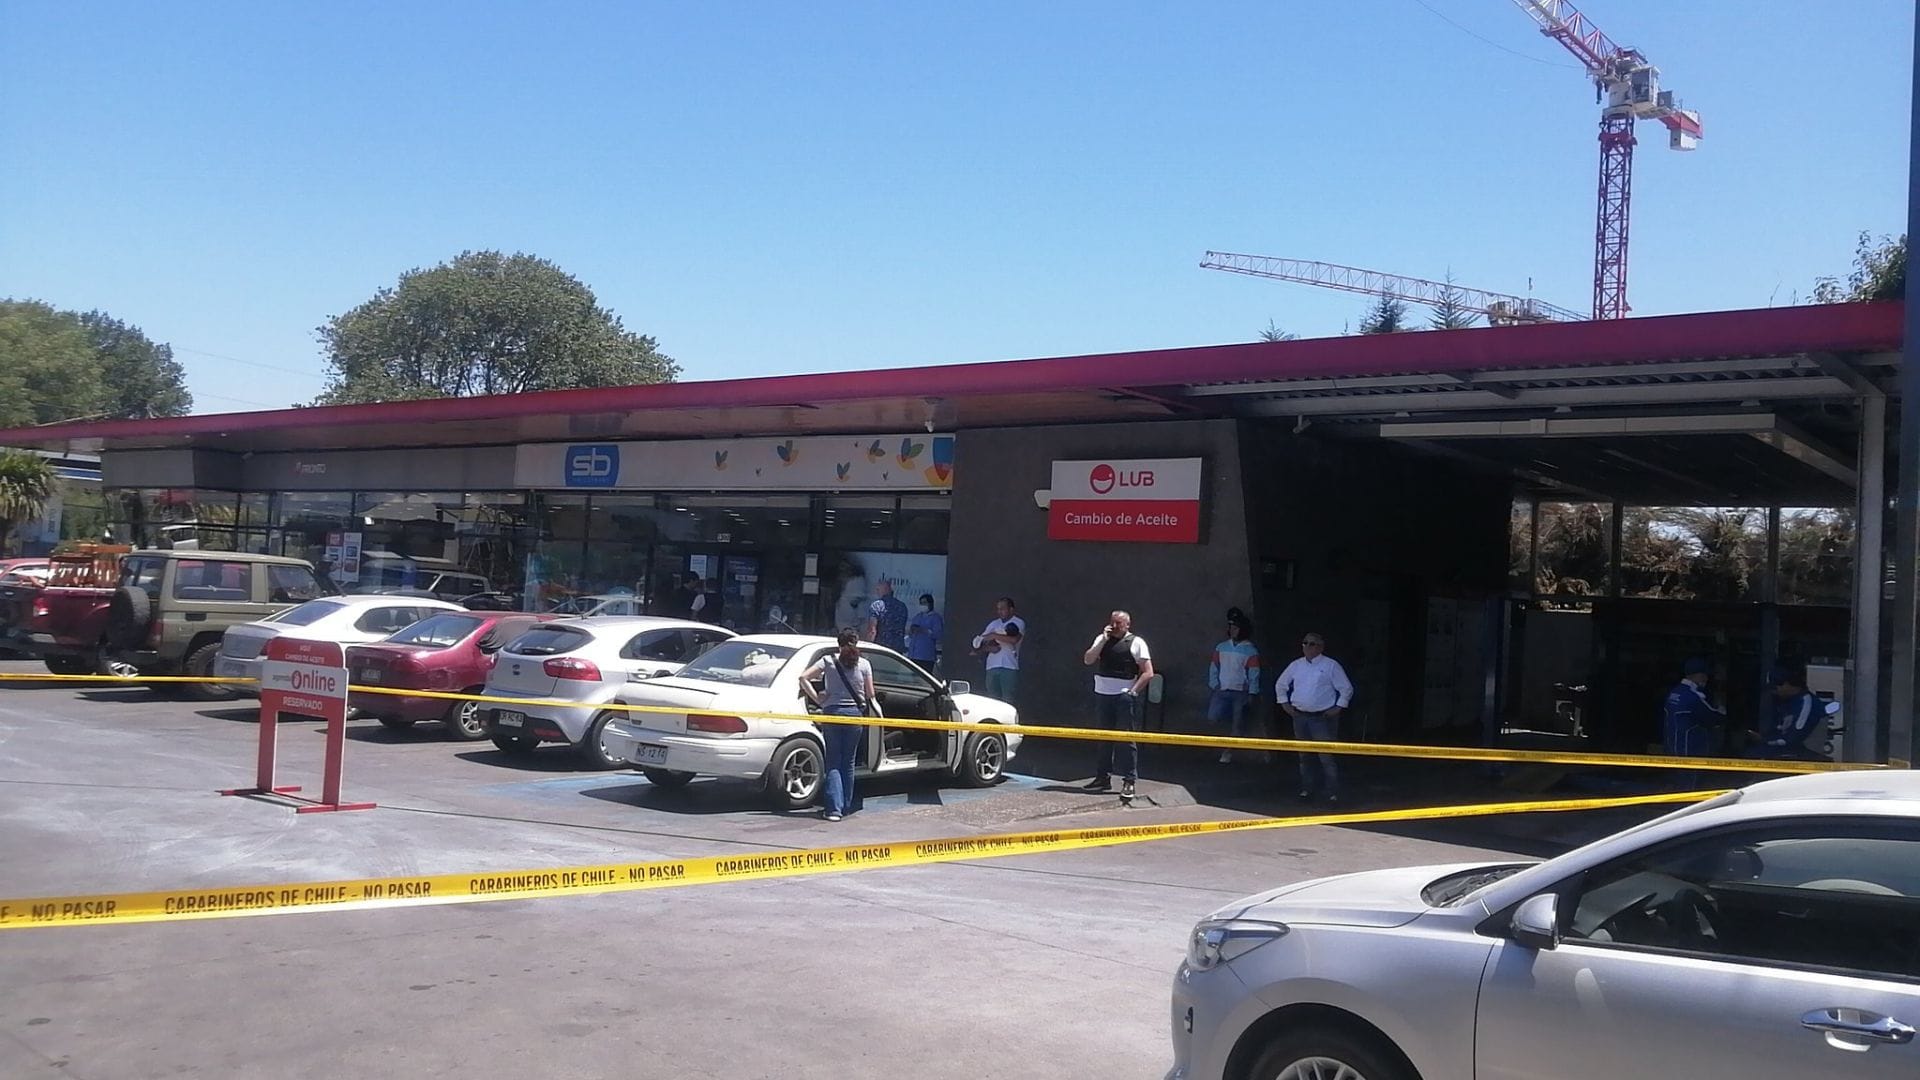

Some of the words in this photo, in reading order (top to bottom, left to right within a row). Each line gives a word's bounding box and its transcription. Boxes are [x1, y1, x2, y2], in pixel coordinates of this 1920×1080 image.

[572, 447, 611, 476] sb
[1119, 471, 1154, 487] LUB
[1065, 512, 1112, 525] Cambio
[1116, 512, 1131, 525] de
[1136, 513, 1178, 526] Aceite
[291, 669, 336, 692] Online
[283, 696, 322, 710] RESERVADO
[916, 841, 975, 857] CARABINEROS
[716, 856, 788, 875] CARABINEROS
[791, 854, 804, 868] DE
[807, 852, 836, 867] CHILE
[845, 850, 859, 864] NO
[861, 847, 892, 862] PASAR
[470, 873, 557, 894] CARABINEROS
[562, 872, 578, 888] DE
[582, 869, 616, 886] CHILE
[629, 867, 645, 882] NO
[649, 864, 685, 880] PASAR
[165, 891, 275, 914] CARABINEROS
[281, 889, 299, 907] DE
[305, 886, 347, 905] CHILE
[363, 884, 383, 900] NO
[388, 881, 432, 898] PASAR
[31, 903, 56, 922] NO
[62, 900, 117, 920] PASAR
